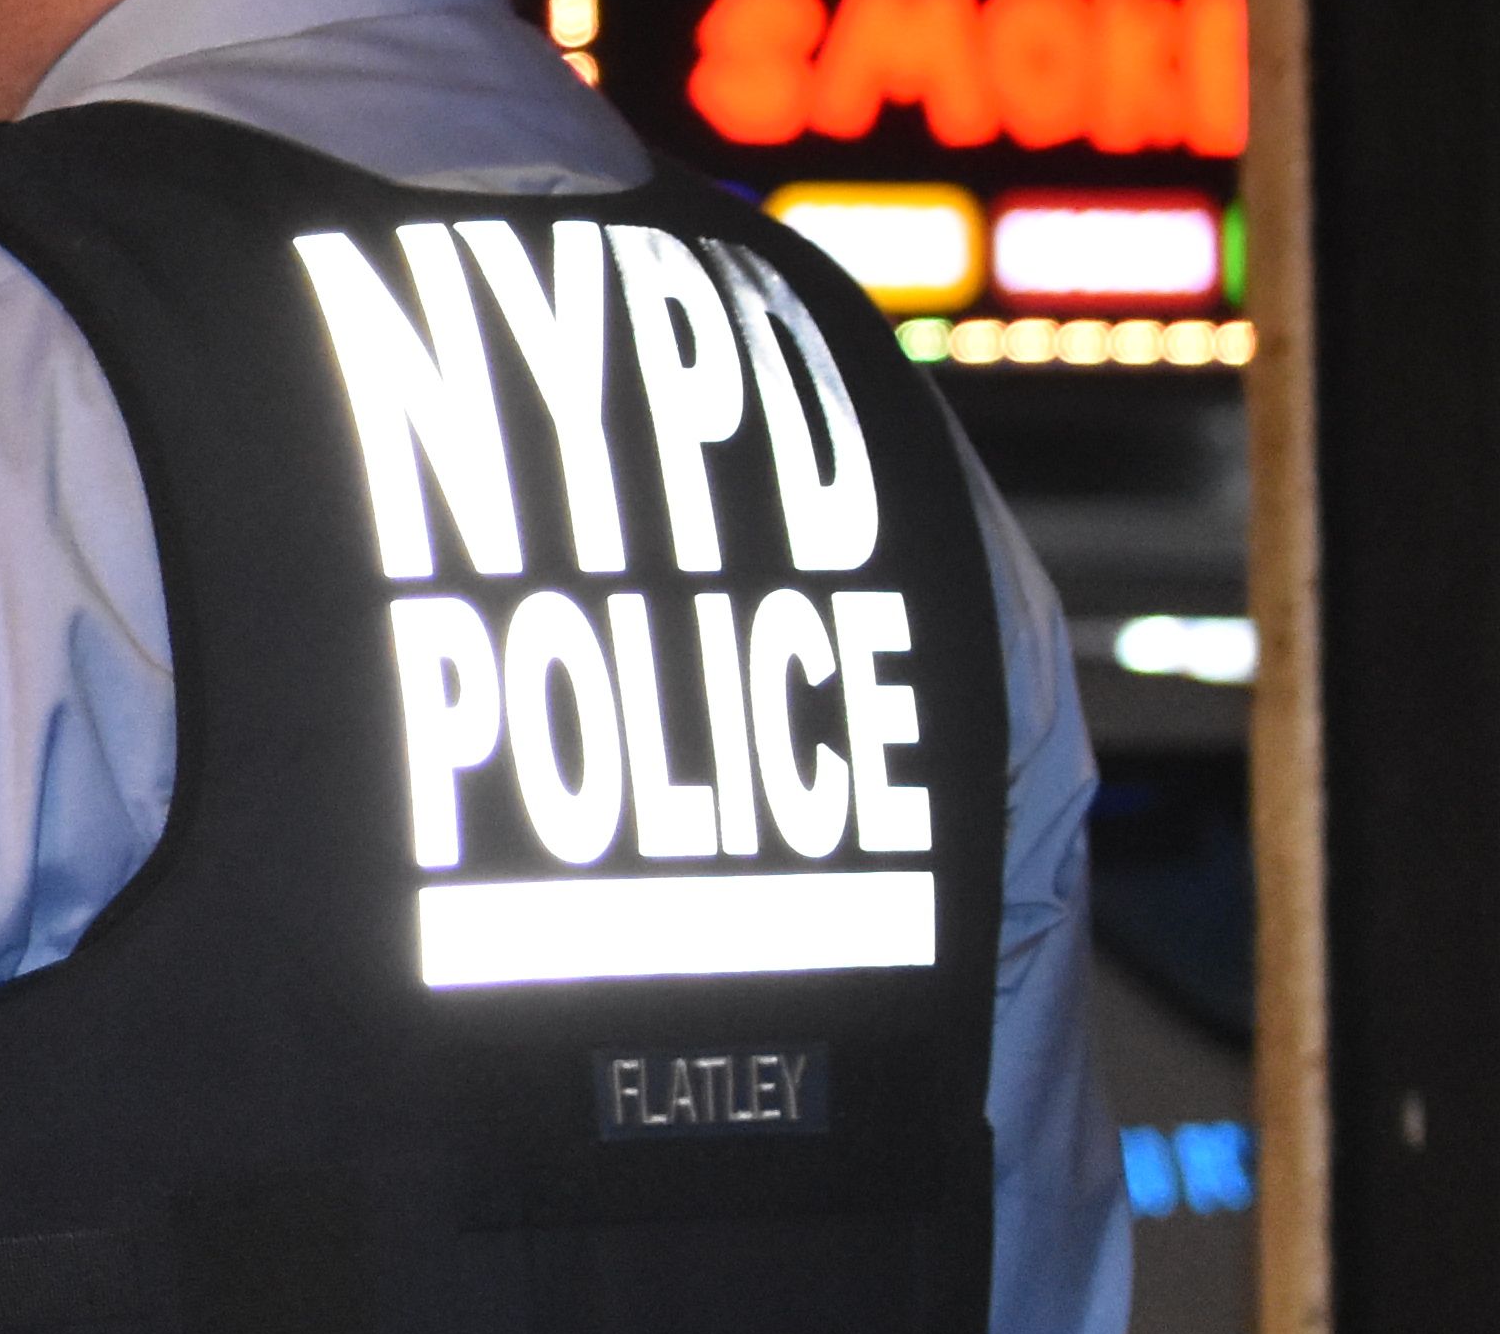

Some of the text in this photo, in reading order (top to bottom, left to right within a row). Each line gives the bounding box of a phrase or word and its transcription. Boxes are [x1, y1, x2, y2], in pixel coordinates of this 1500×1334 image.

[292, 219, 880, 579] NYPD
[388, 587, 934, 869] POLICE
[612, 1054, 806, 1125] FLATLEY
